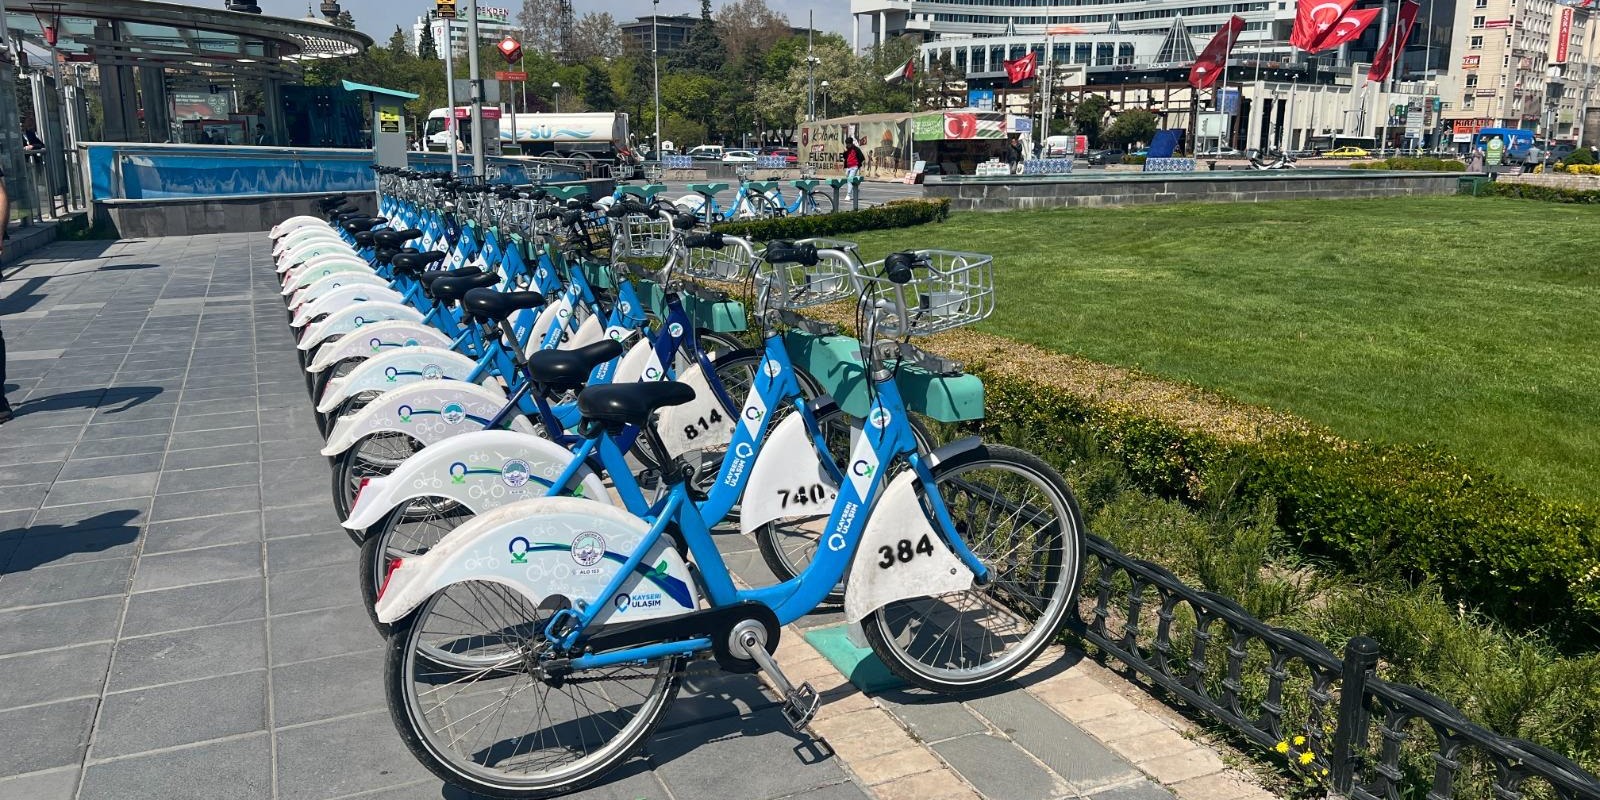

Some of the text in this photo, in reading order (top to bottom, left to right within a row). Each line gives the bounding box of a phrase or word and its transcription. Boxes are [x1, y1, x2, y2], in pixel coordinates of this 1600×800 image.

[1561, 10, 1570, 33] ESRA
[684, 409, 722, 439] 814
[777, 483, 825, 509] 740
[878, 533, 934, 569] 384
[632, 600, 661, 608] ULAŞIM
